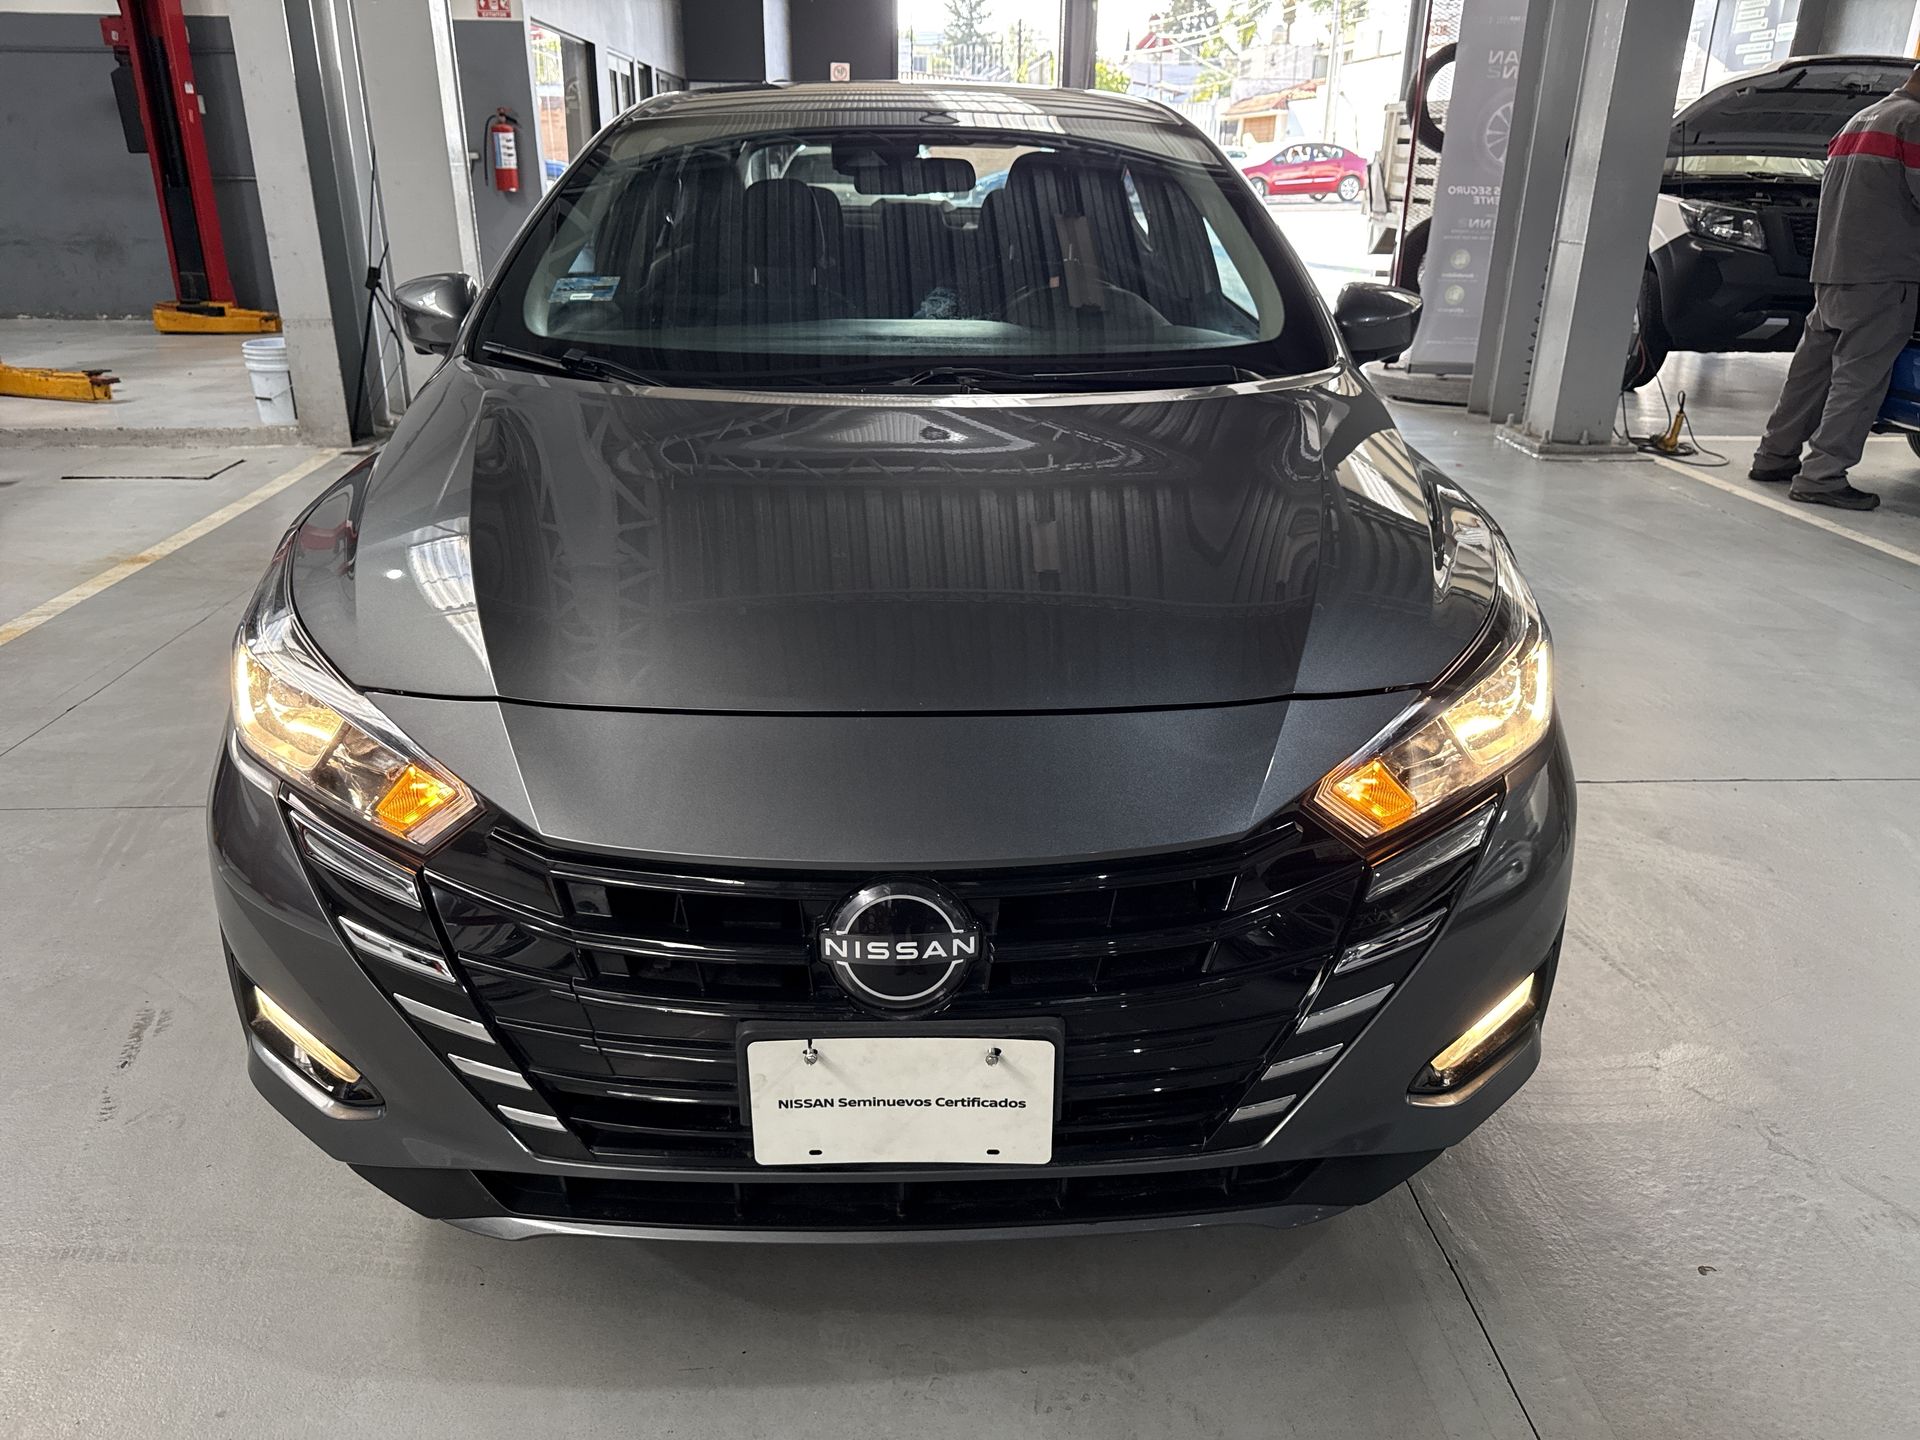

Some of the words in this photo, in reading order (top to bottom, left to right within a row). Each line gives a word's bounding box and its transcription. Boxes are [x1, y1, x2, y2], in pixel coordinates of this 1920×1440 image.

[824, 935, 975, 960] NISSAN
[778, 1098, 834, 1109] NISSAN
[838, 1096, 932, 1108] Seminuevos
[935, 1097, 1027, 1109] Certificados
